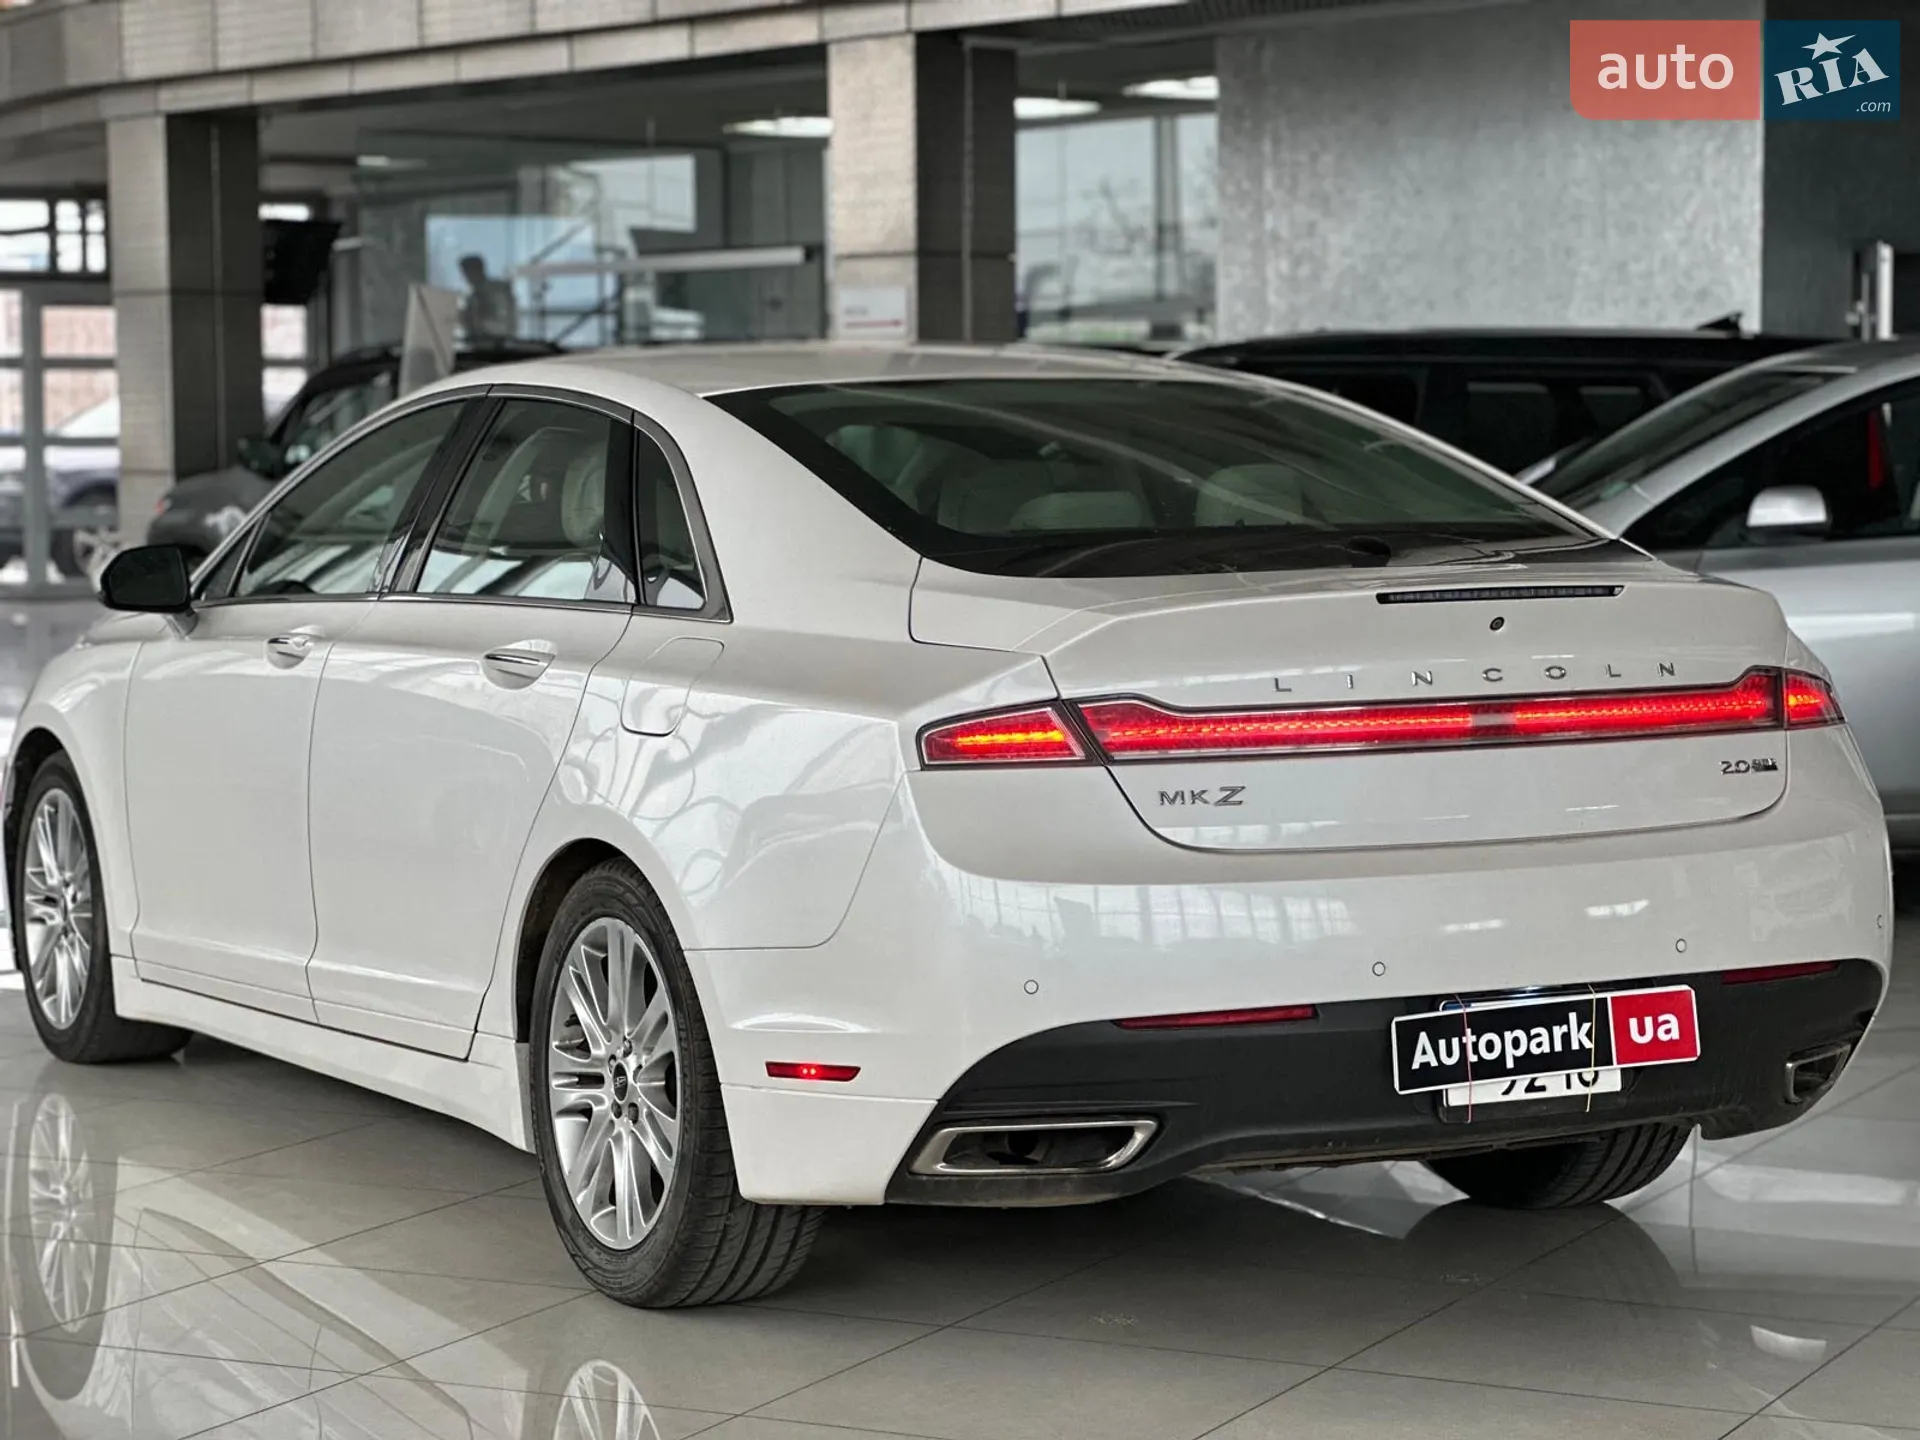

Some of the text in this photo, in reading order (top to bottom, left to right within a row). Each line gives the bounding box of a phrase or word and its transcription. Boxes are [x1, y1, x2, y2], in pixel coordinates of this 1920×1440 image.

[1274, 662, 1676, 693] LINCOLN
[1158, 785, 1246, 807] MKZ
[1411, 1012, 1681, 1070] Autopark ua
